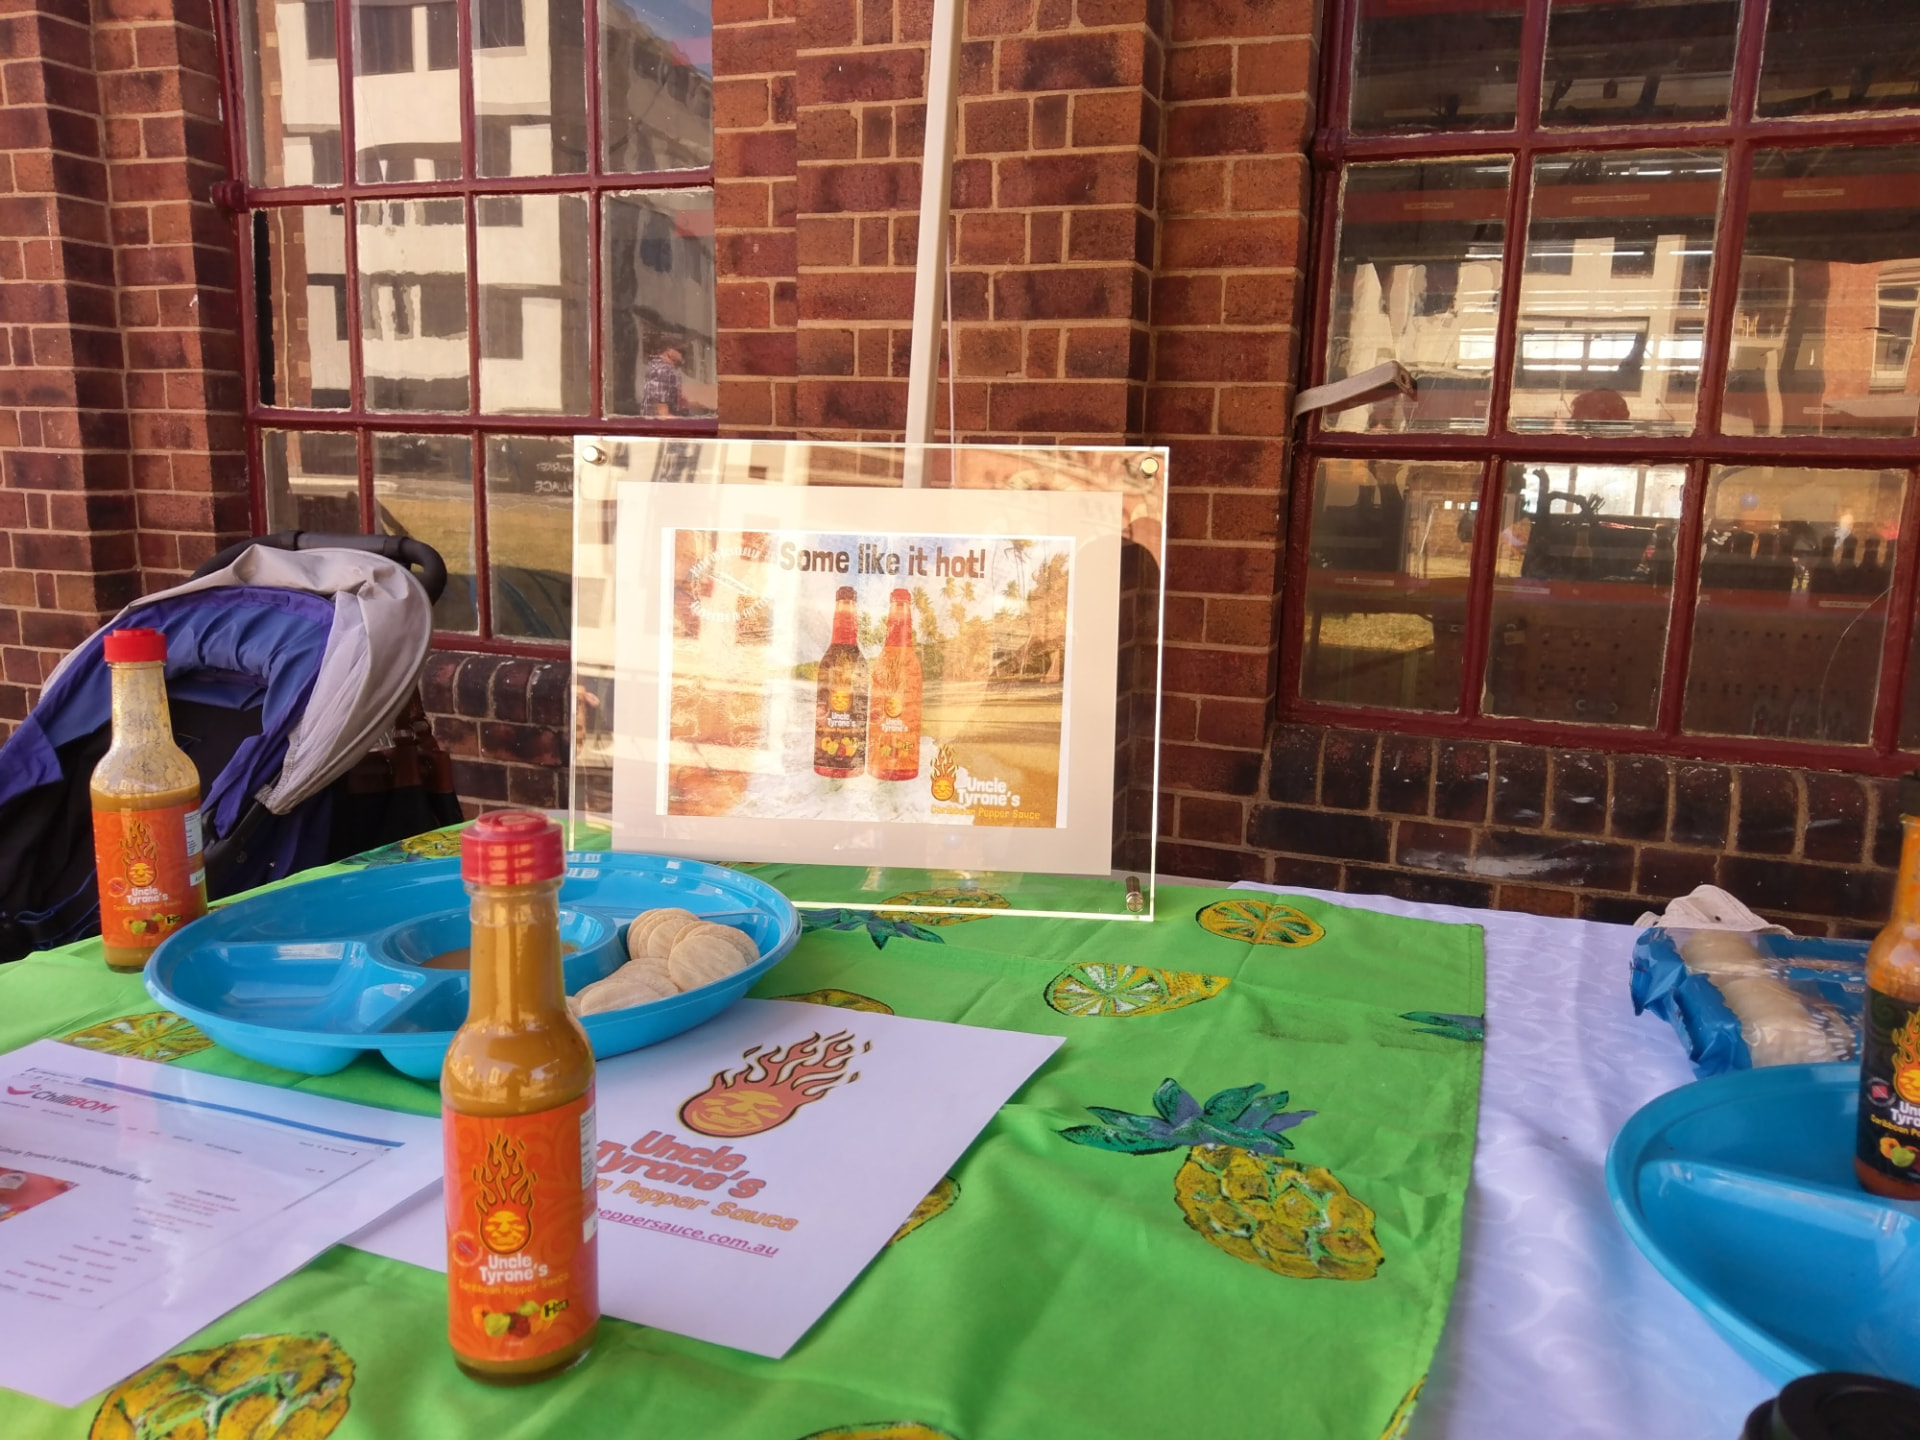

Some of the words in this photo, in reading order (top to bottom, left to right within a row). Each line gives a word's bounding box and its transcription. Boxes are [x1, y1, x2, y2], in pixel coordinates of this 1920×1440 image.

[780, 541, 849, 573] Some
[858, 543, 900, 575] like
[908, 545, 927, 576] it
[936, 546, 986, 578] hot!
[967, 777, 1007, 793] Uncle
[957, 788, 1020, 807] Tyrone's
[979, 807, 1010, 819] Pepper
[1013, 810, 1041, 820] Sauce
[126, 891, 169, 904] Tyrone's
[131, 886, 158, 896] Uncle
[31, 1090, 119, 1113] ChilliBOM
[631, 1130, 747, 1172] Uncle
[597, 1140, 767, 1199] Tyrone's
[614, 1179, 710, 1210] Pepper
[711, 1201, 799, 1231] Sauce
[598, 1207, 779, 1257] eppersauce.com.au
[488, 1253, 532, 1269] Uncle
[479, 1264, 549, 1286] Tyrone's
